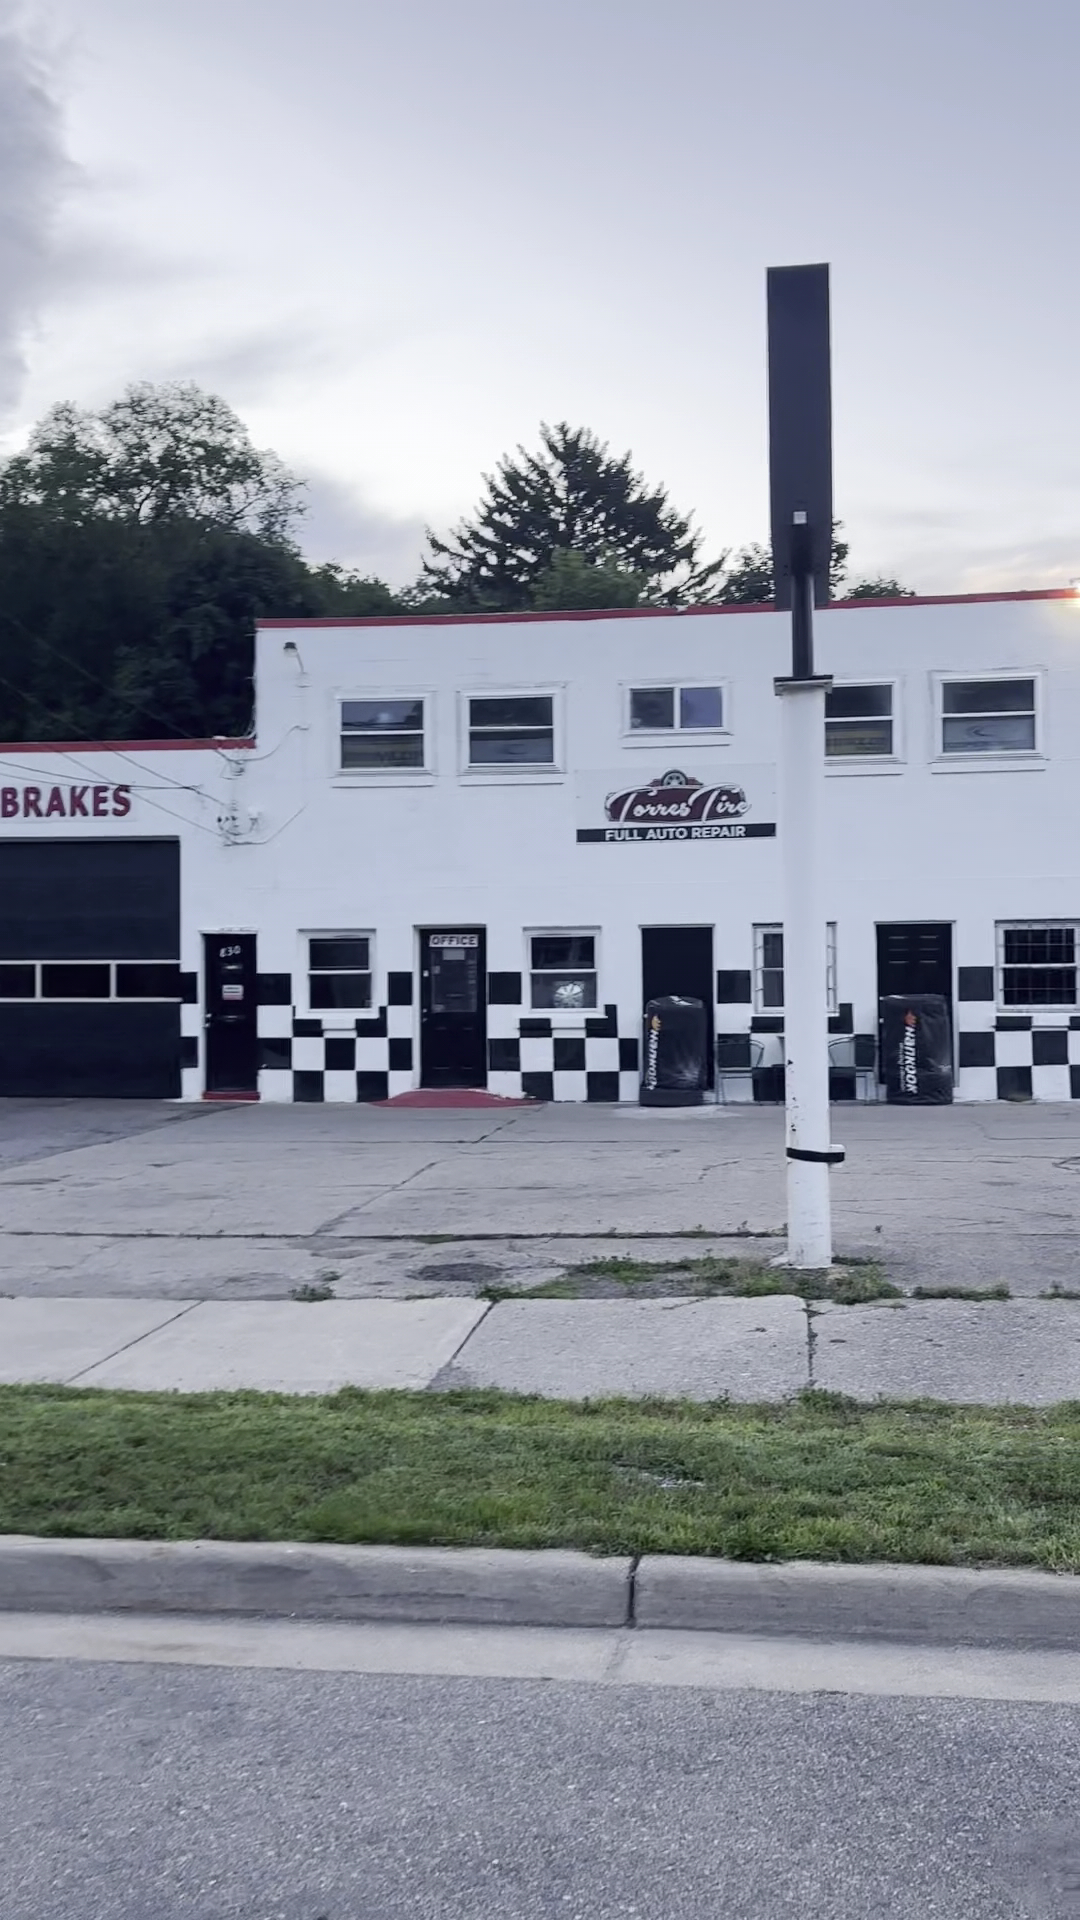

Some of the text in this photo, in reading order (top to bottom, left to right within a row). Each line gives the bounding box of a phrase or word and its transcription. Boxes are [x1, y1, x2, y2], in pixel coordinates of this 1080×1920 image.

[1, 785, 132, 818] BRAKES
[605, 782, 752, 824] Torres Tire
[605, 825, 746, 841] FULL AUTO REPAIR
[431, 935, 477, 946] OFFICE
